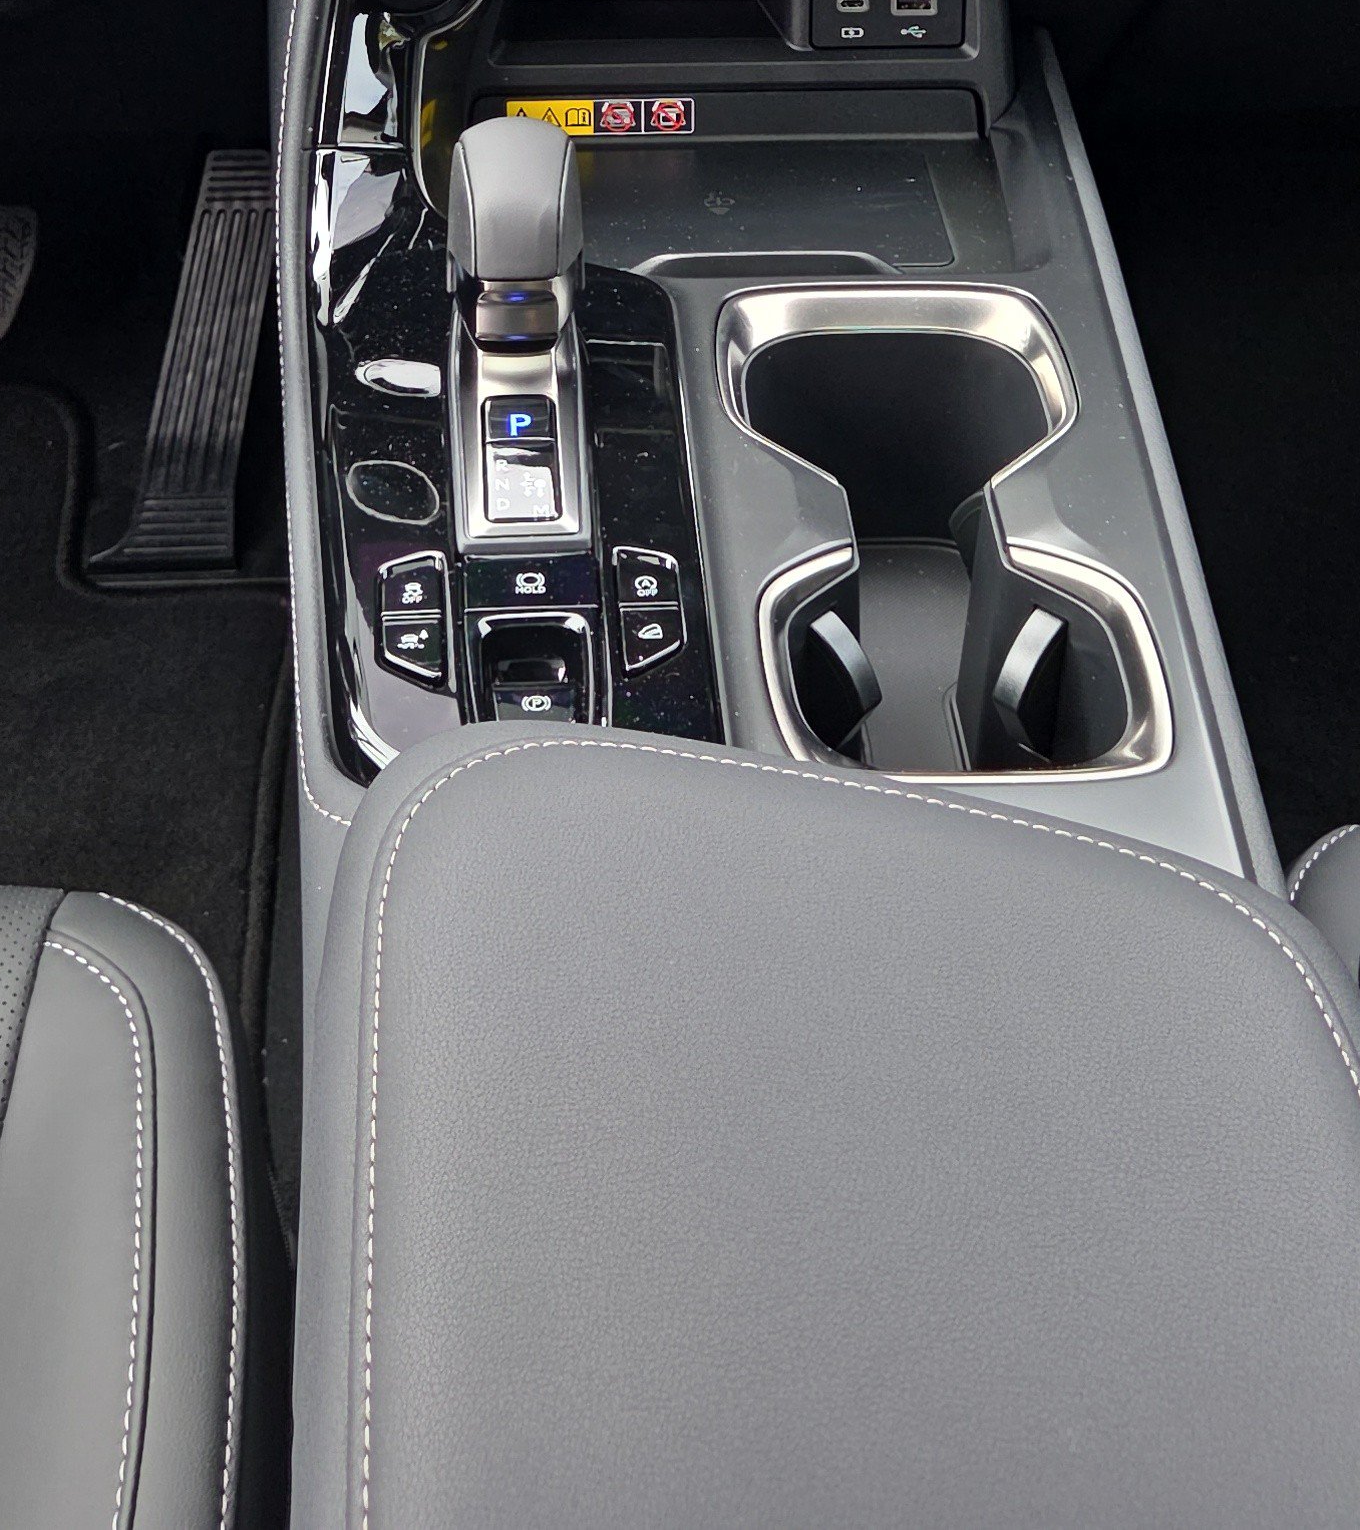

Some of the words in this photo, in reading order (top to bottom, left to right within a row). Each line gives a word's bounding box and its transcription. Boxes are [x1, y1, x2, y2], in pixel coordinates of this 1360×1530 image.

[510, 413, 532, 437] P
[495, 477, 510, 491] N
[496, 497, 511, 511] D
[514, 585, 547, 595] HOLD
[637, 588, 658, 597] OFF
[401, 595, 423, 604] OFF
